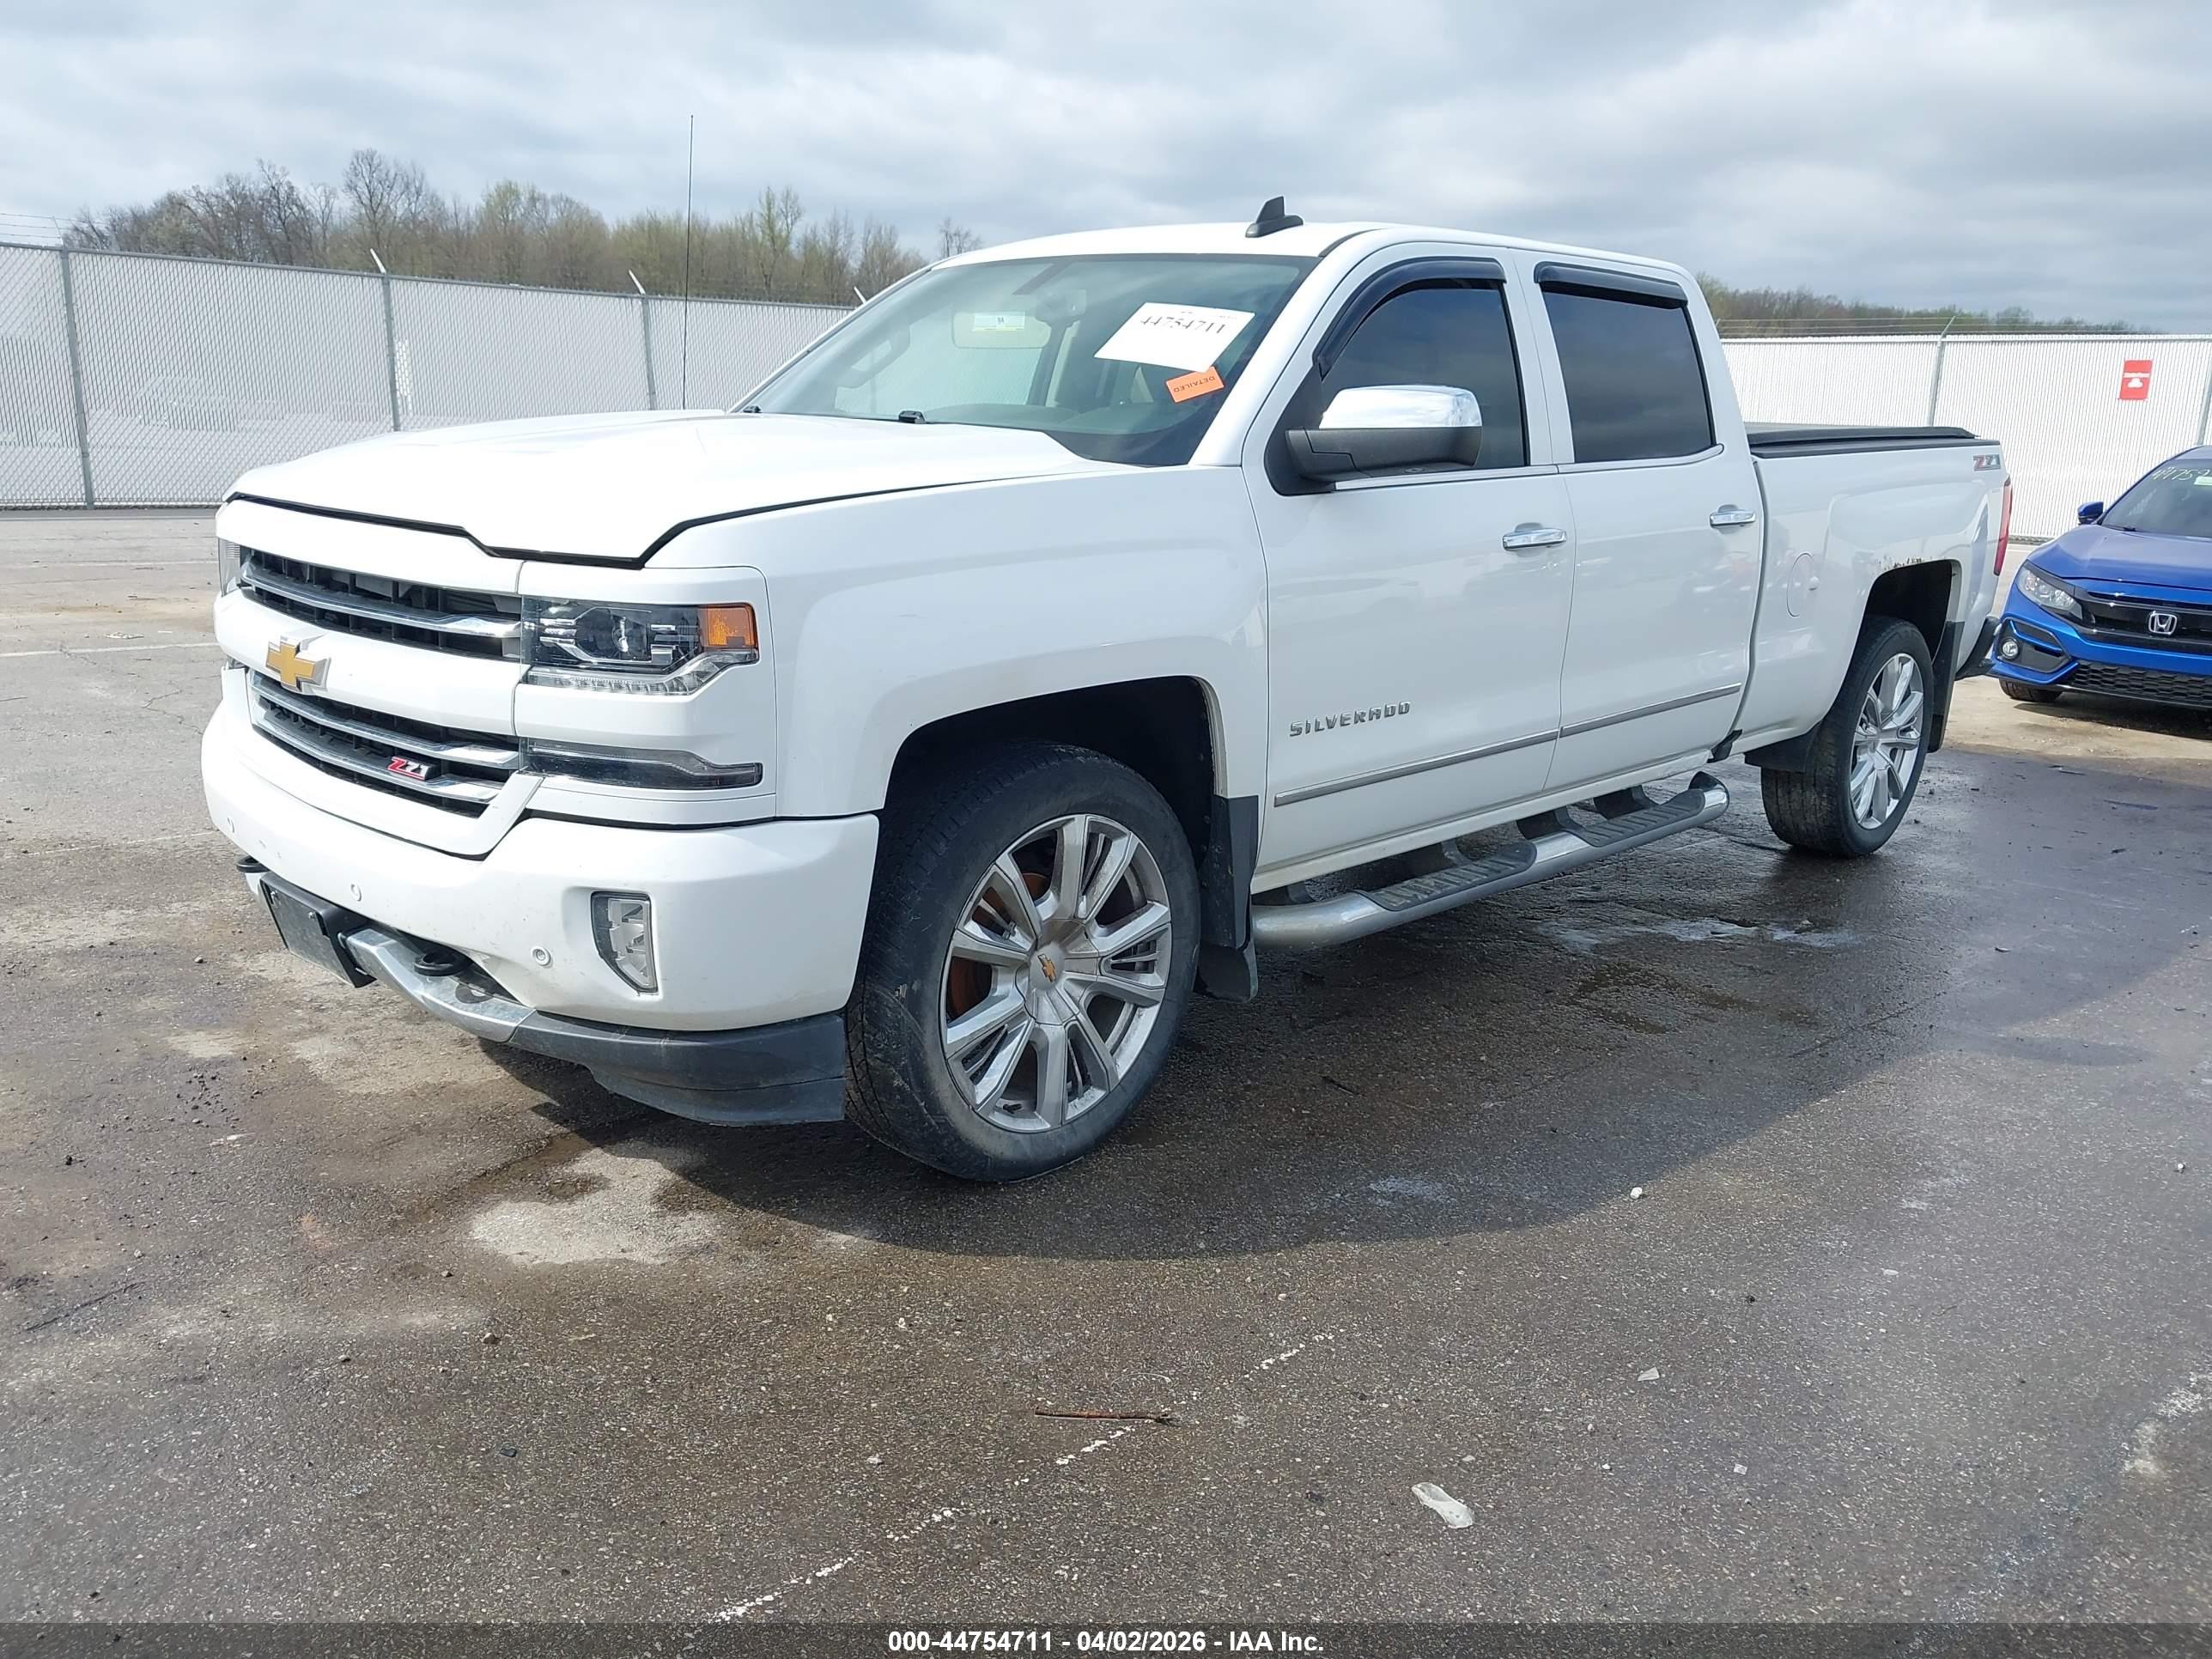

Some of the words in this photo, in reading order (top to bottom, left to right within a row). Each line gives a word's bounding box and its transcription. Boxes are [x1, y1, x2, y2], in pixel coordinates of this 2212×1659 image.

[1173, 375, 1216, 392] DETAILED
[1972, 454, 2001, 471] Z71
[1289, 701, 1412, 737] SILVERADO
[387, 756, 430, 781] Z71
